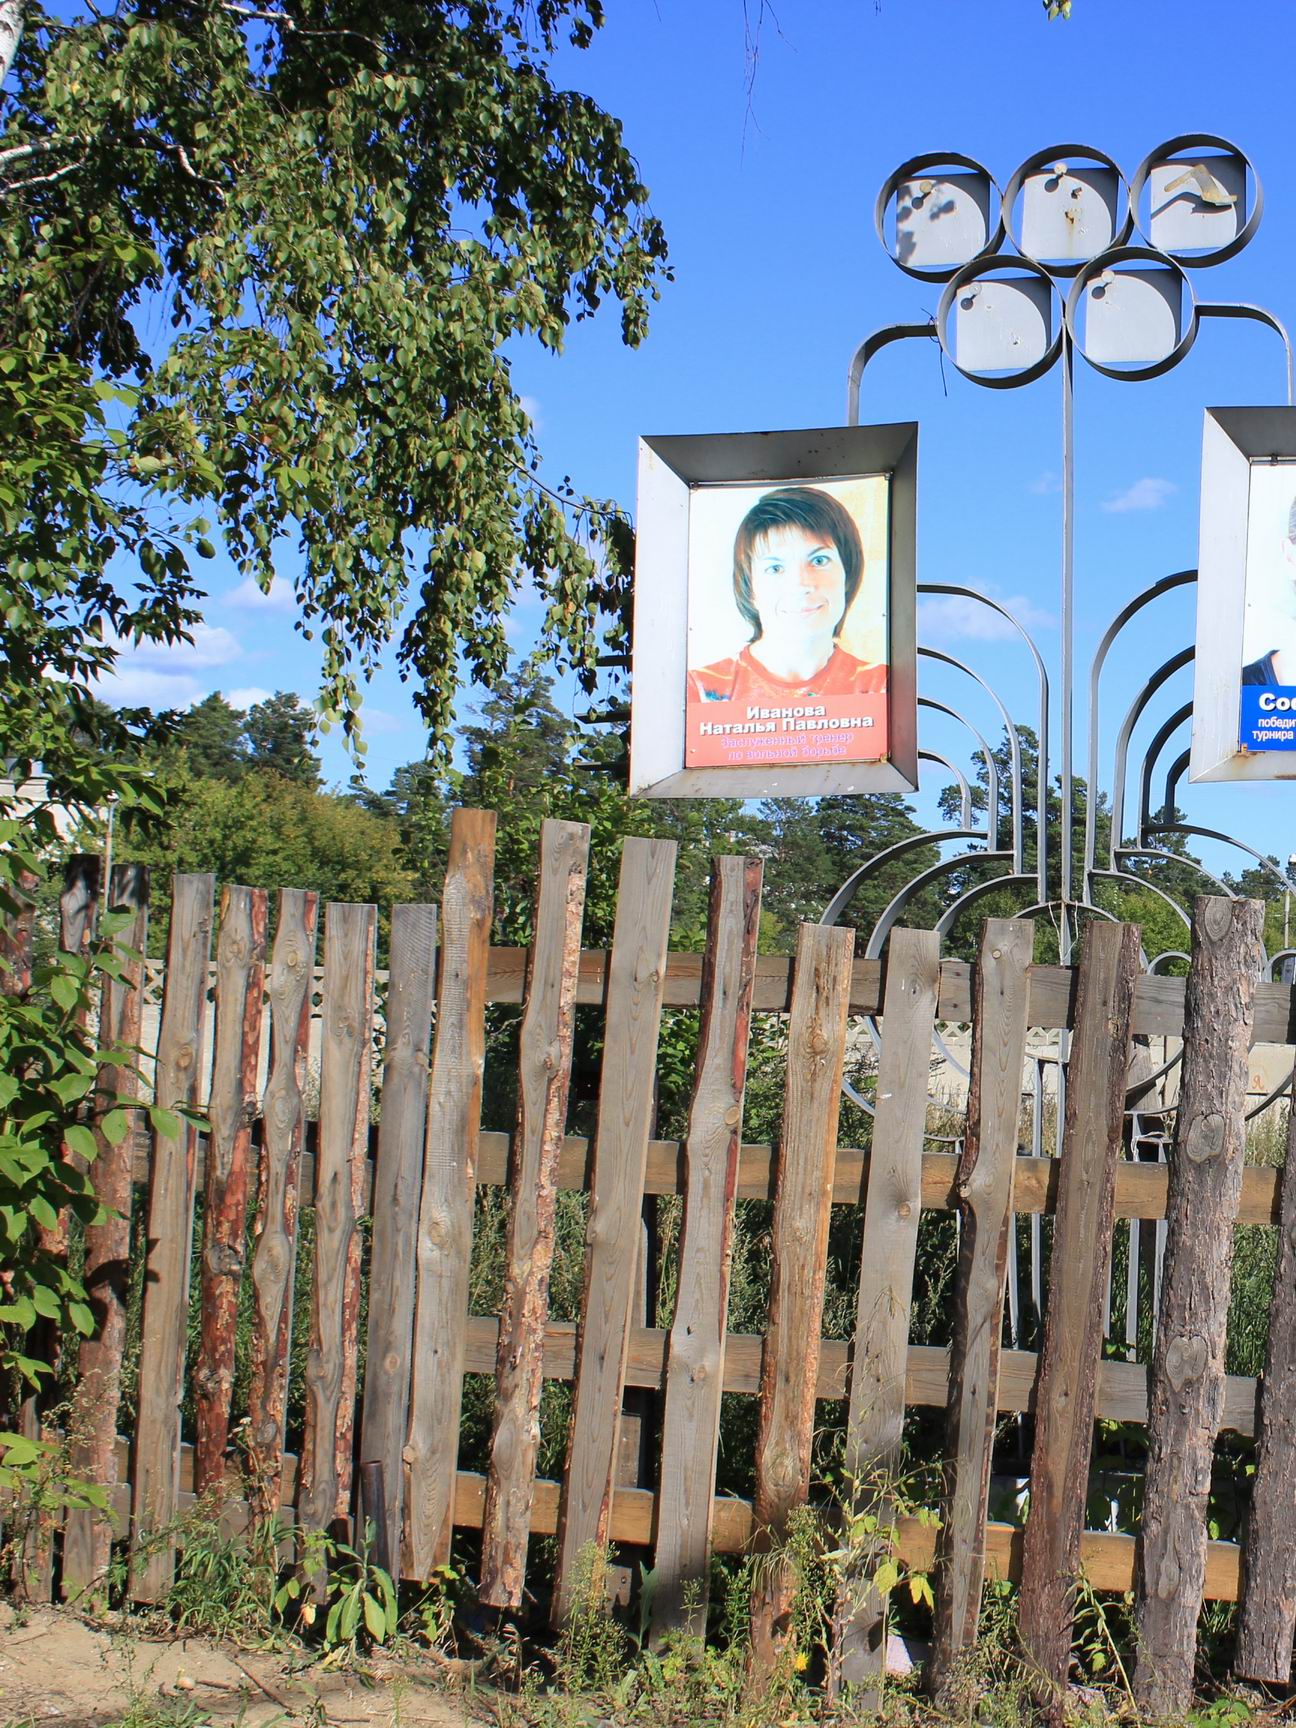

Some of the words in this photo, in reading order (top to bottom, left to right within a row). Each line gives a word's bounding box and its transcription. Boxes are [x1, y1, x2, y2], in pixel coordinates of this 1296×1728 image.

[746, 704, 826, 720] Иванова
[699, 720, 777, 736] Наталья
[782, 715, 874, 732] Павловна
[1252, 730, 1293, 741] турнира
